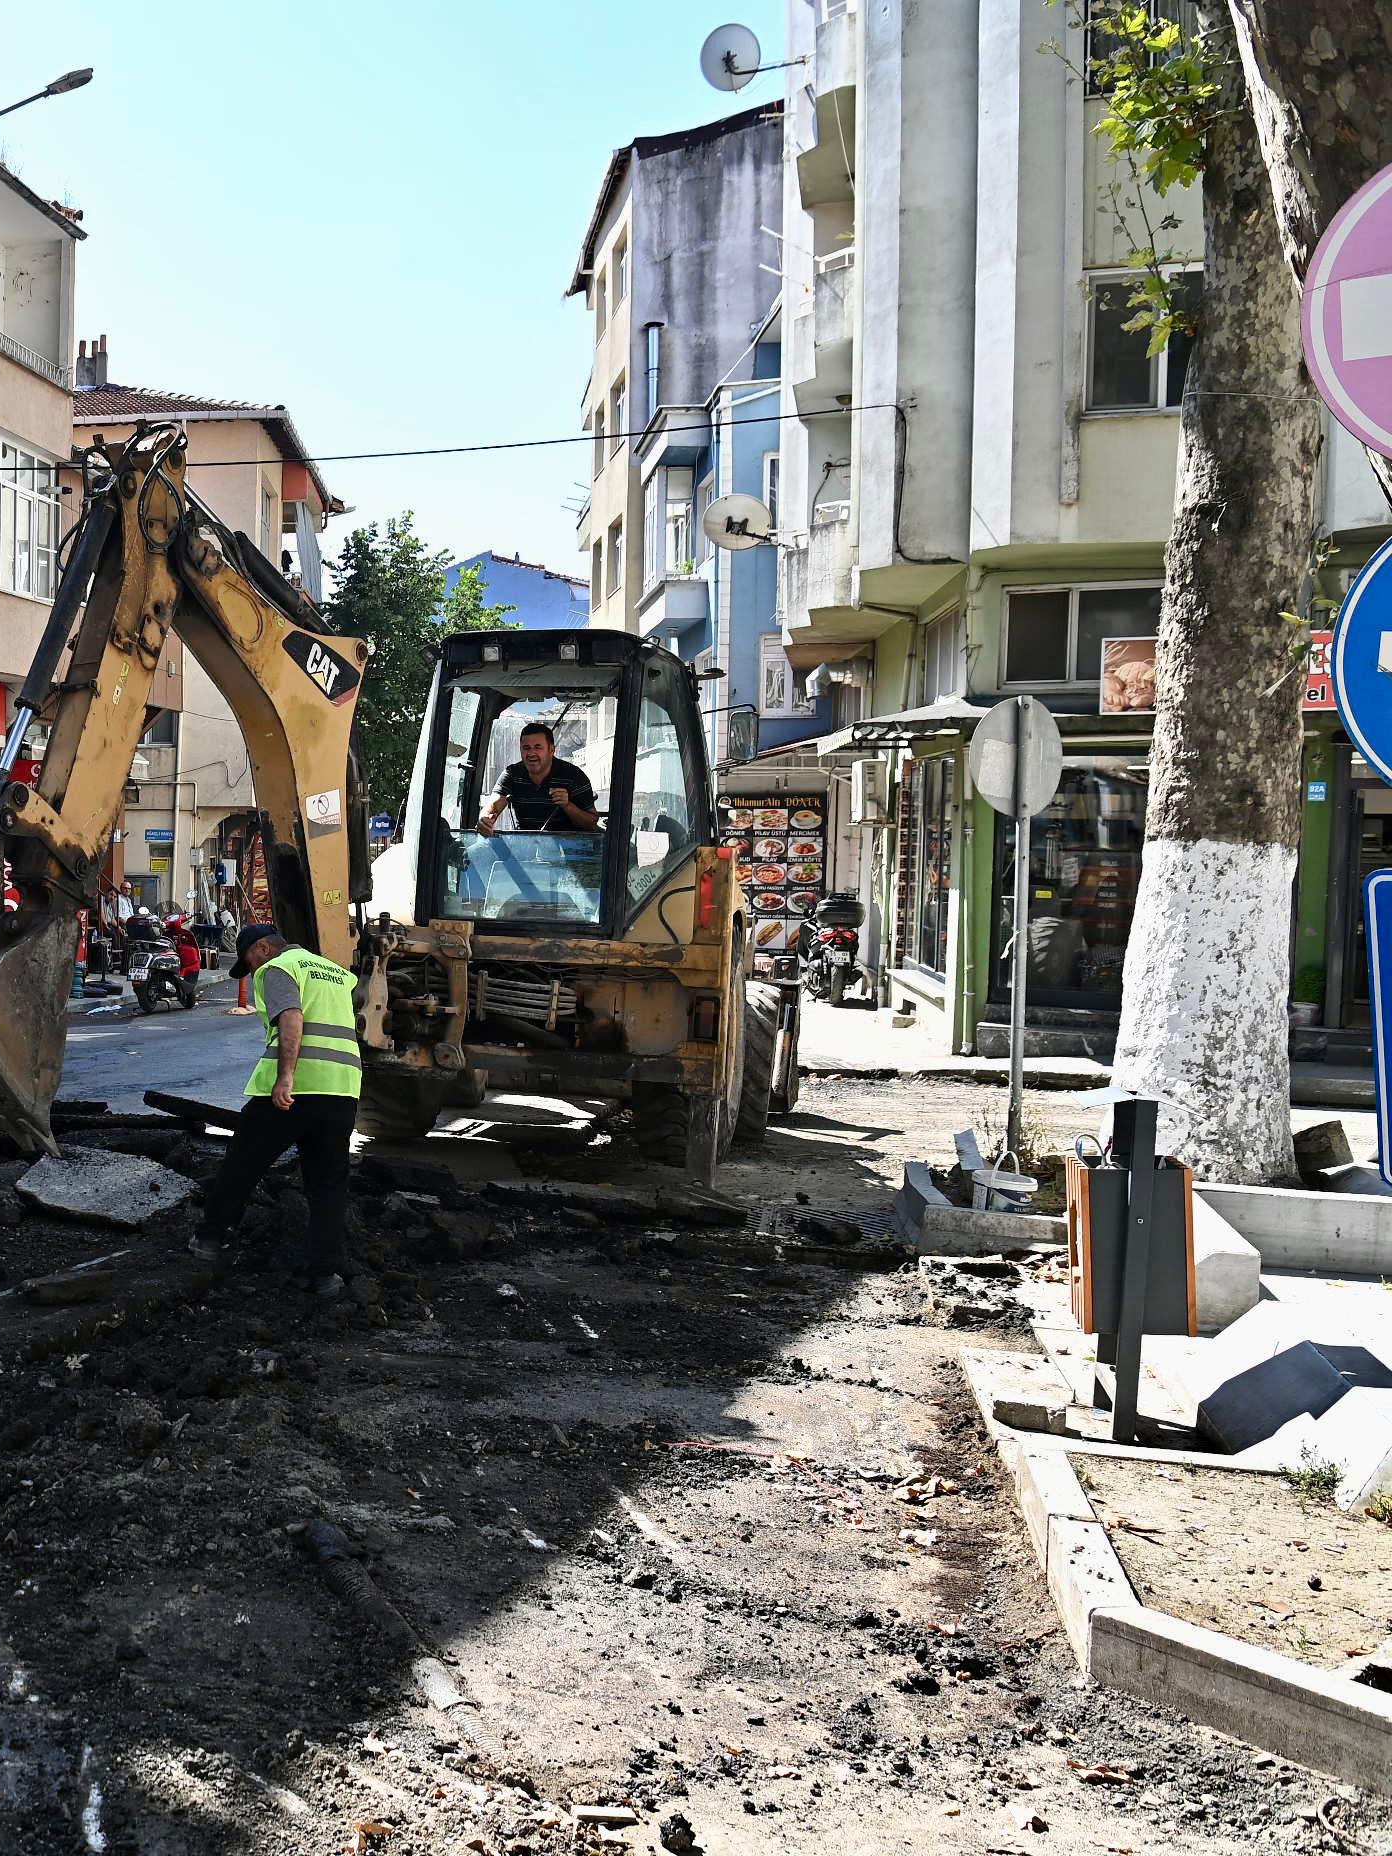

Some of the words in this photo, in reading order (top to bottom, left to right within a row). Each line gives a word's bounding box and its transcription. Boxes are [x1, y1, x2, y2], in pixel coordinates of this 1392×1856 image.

[306, 642, 340, 695] CAT
[785, 796, 821, 808] DÖNER
[635, 871, 656, 894] 13004
[310, 970, 345, 986] BELEDİYESİ
